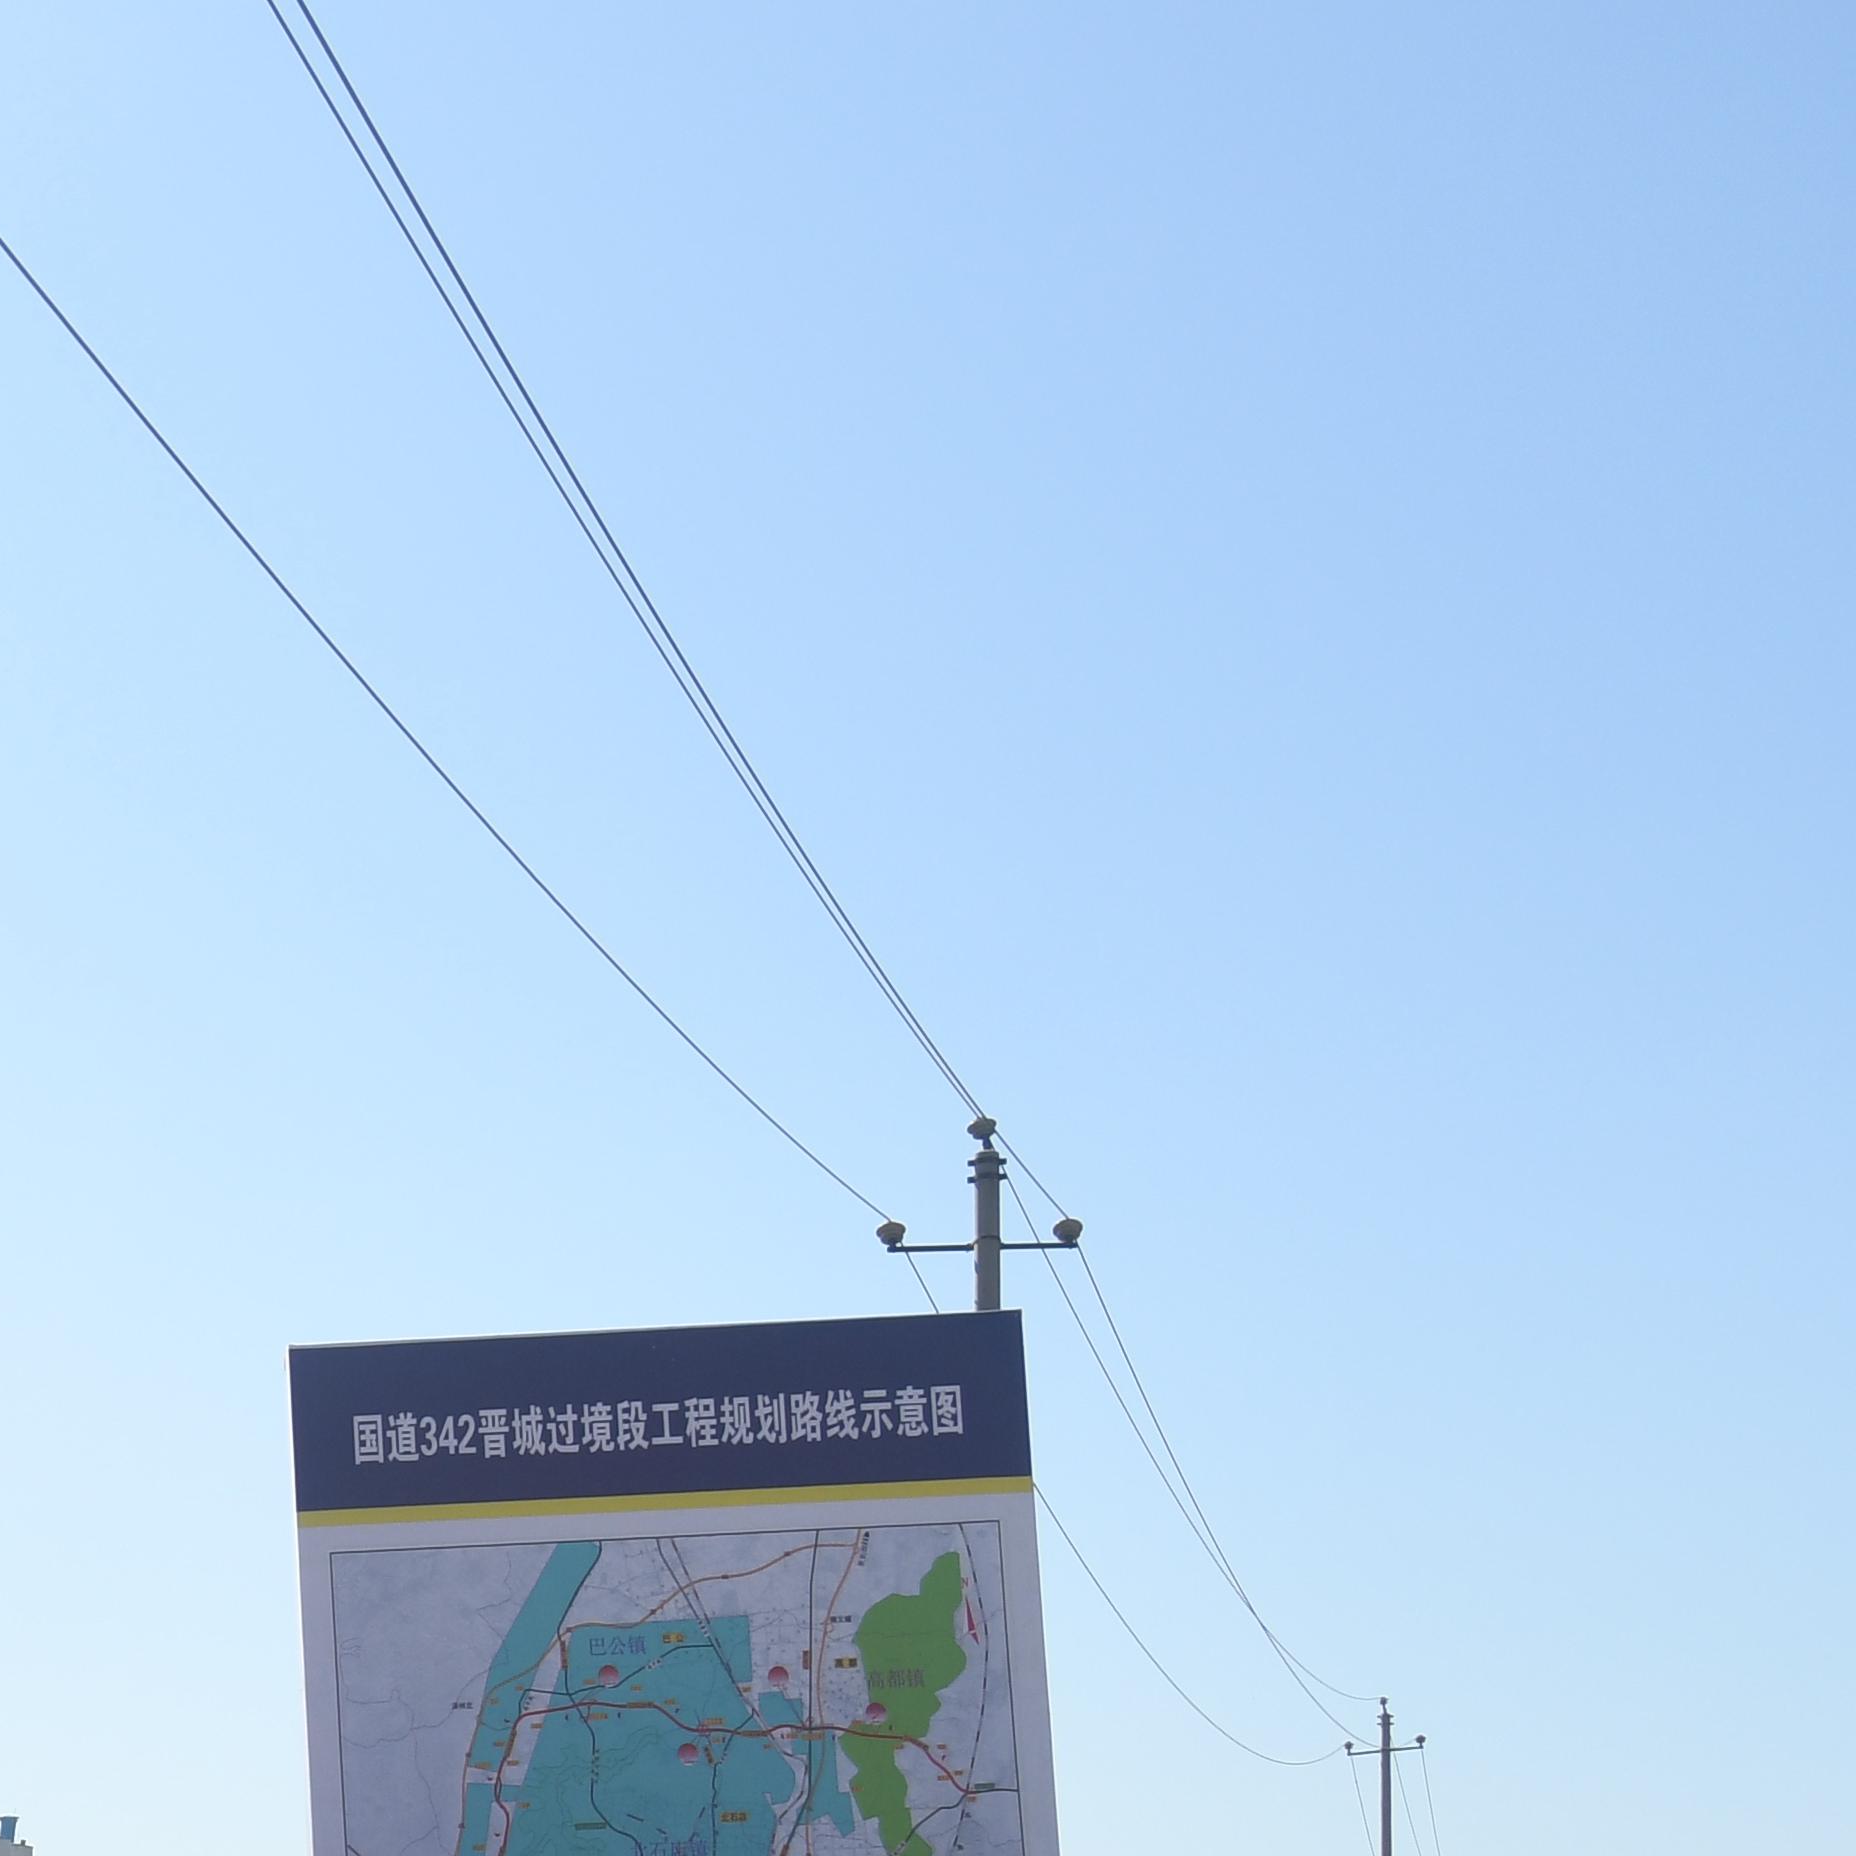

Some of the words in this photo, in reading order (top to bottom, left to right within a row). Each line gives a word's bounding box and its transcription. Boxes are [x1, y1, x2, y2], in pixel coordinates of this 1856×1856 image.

[352, 1384, 965, 1466] 国道342晋城过境段工程规划路线示意图
[588, 1635, 647, 1656] 巴公镇
[868, 1668, 925, 1689] 高都镇
